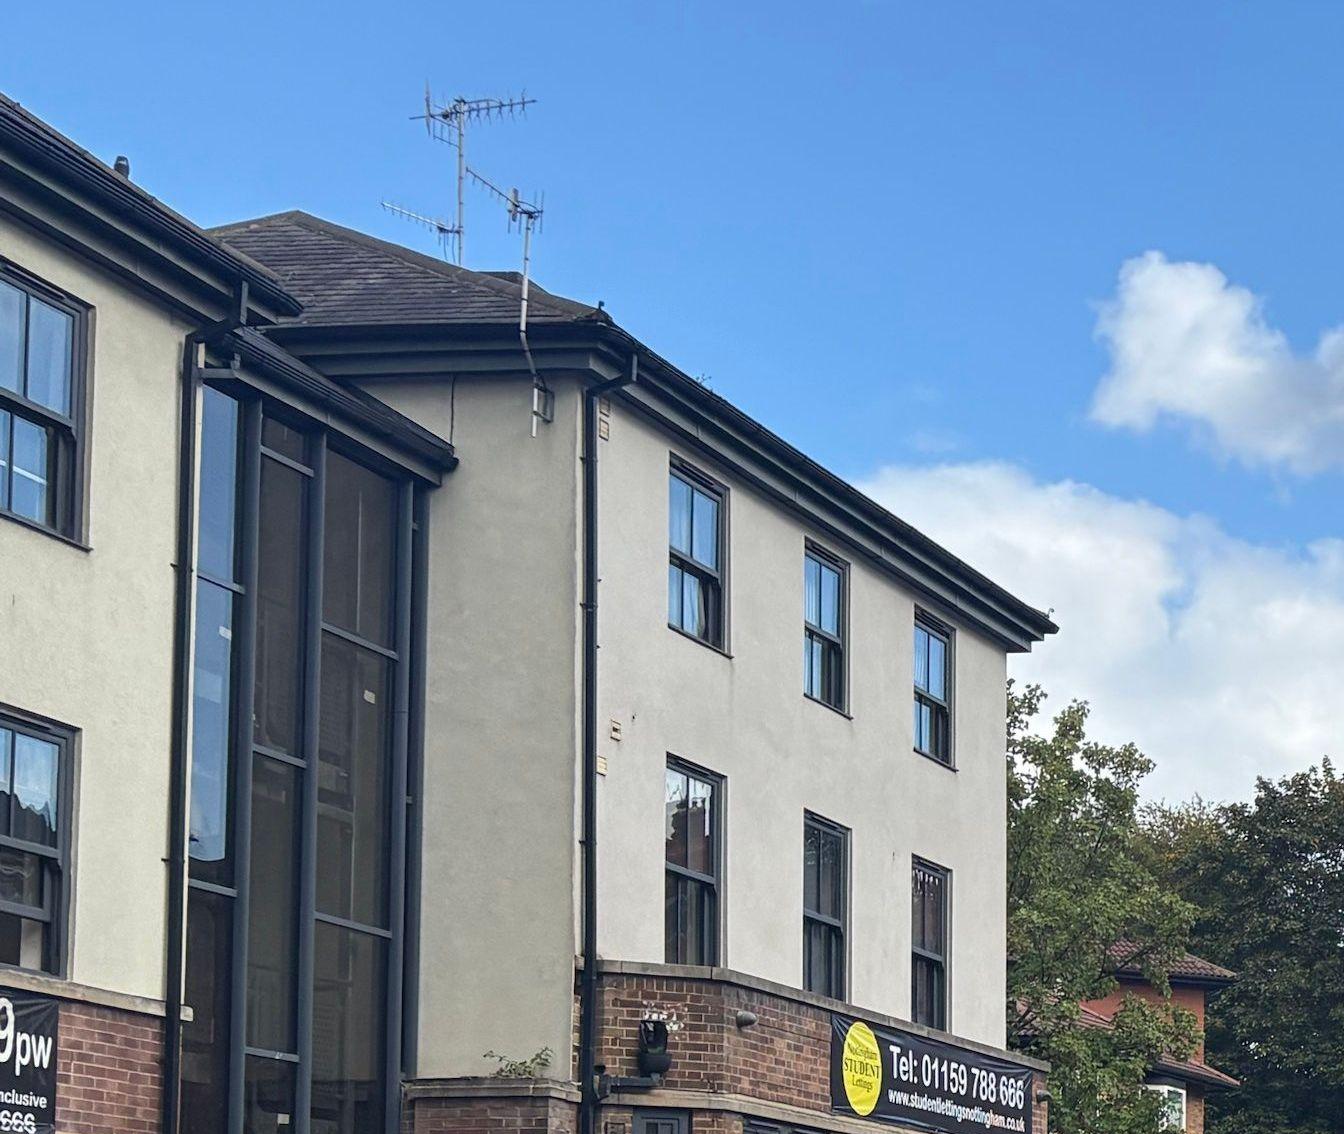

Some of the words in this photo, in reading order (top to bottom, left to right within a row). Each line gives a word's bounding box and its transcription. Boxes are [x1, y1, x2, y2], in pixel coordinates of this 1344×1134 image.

[844, 1057, 880, 1080] STUDENT
[889, 1045, 918, 1084] Tel:
[921, 1053, 967, 1096] 01159
[971, 1068, 997, 1104] 788
[999, 1075, 1025, 1110] 666
